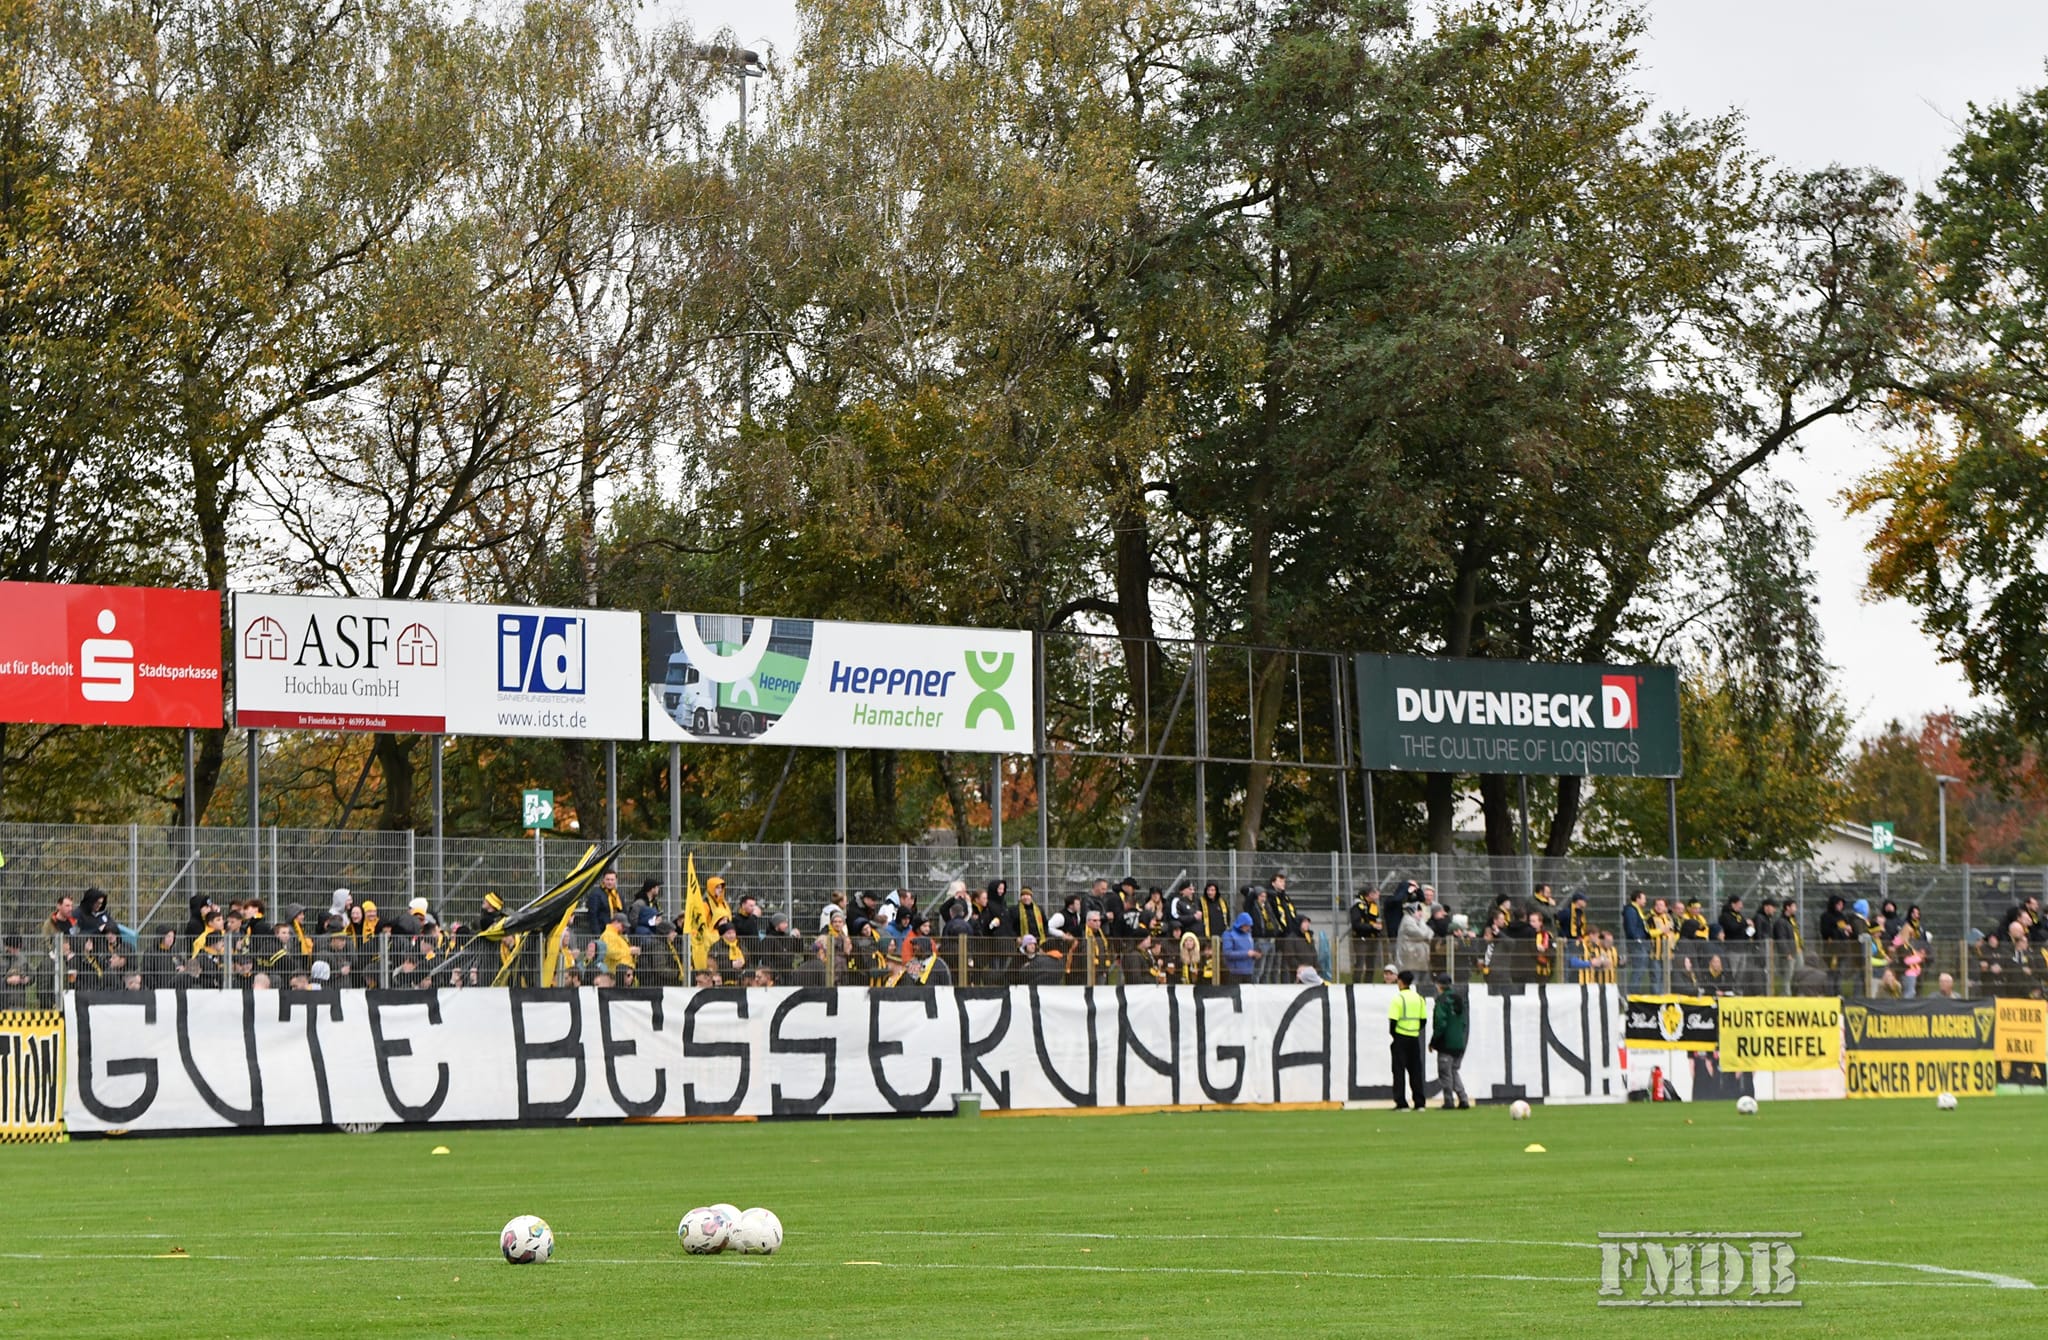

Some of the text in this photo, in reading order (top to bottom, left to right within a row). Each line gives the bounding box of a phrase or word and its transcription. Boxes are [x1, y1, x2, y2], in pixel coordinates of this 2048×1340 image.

[293, 613, 390, 669] ASF
[13, 659, 30, 675] für
[31, 661, 74, 677] Bocholt
[138, 663, 219, 680] Stadtsparkasse
[829, 660, 956, 698] Heppner
[284, 675, 400, 697] Hochbau GmbH
[497, 709, 588, 729] www.idst.de
[853, 703, 943, 728] Hamacher
[1396, 687, 1596, 729] DUVENBECK
[1400, 735, 1640, 764] THE CULTURE OF LOGISTICS
[1721, 1007, 1839, 1028] HÜRTGENWALD
[1866, 1014, 1977, 1039] ALEMANNIA AACHEN
[2000, 1007, 2042, 1023] OECHER
[75, 988, 450, 1124] GUTE
[509, 984, 1246, 1120] BESSERUNG
[1736, 1036, 1826, 1057] RUREIFEL
[1916, 1061, 1971, 1091] POWER
[1974, 1062, 1994, 1092] 98
